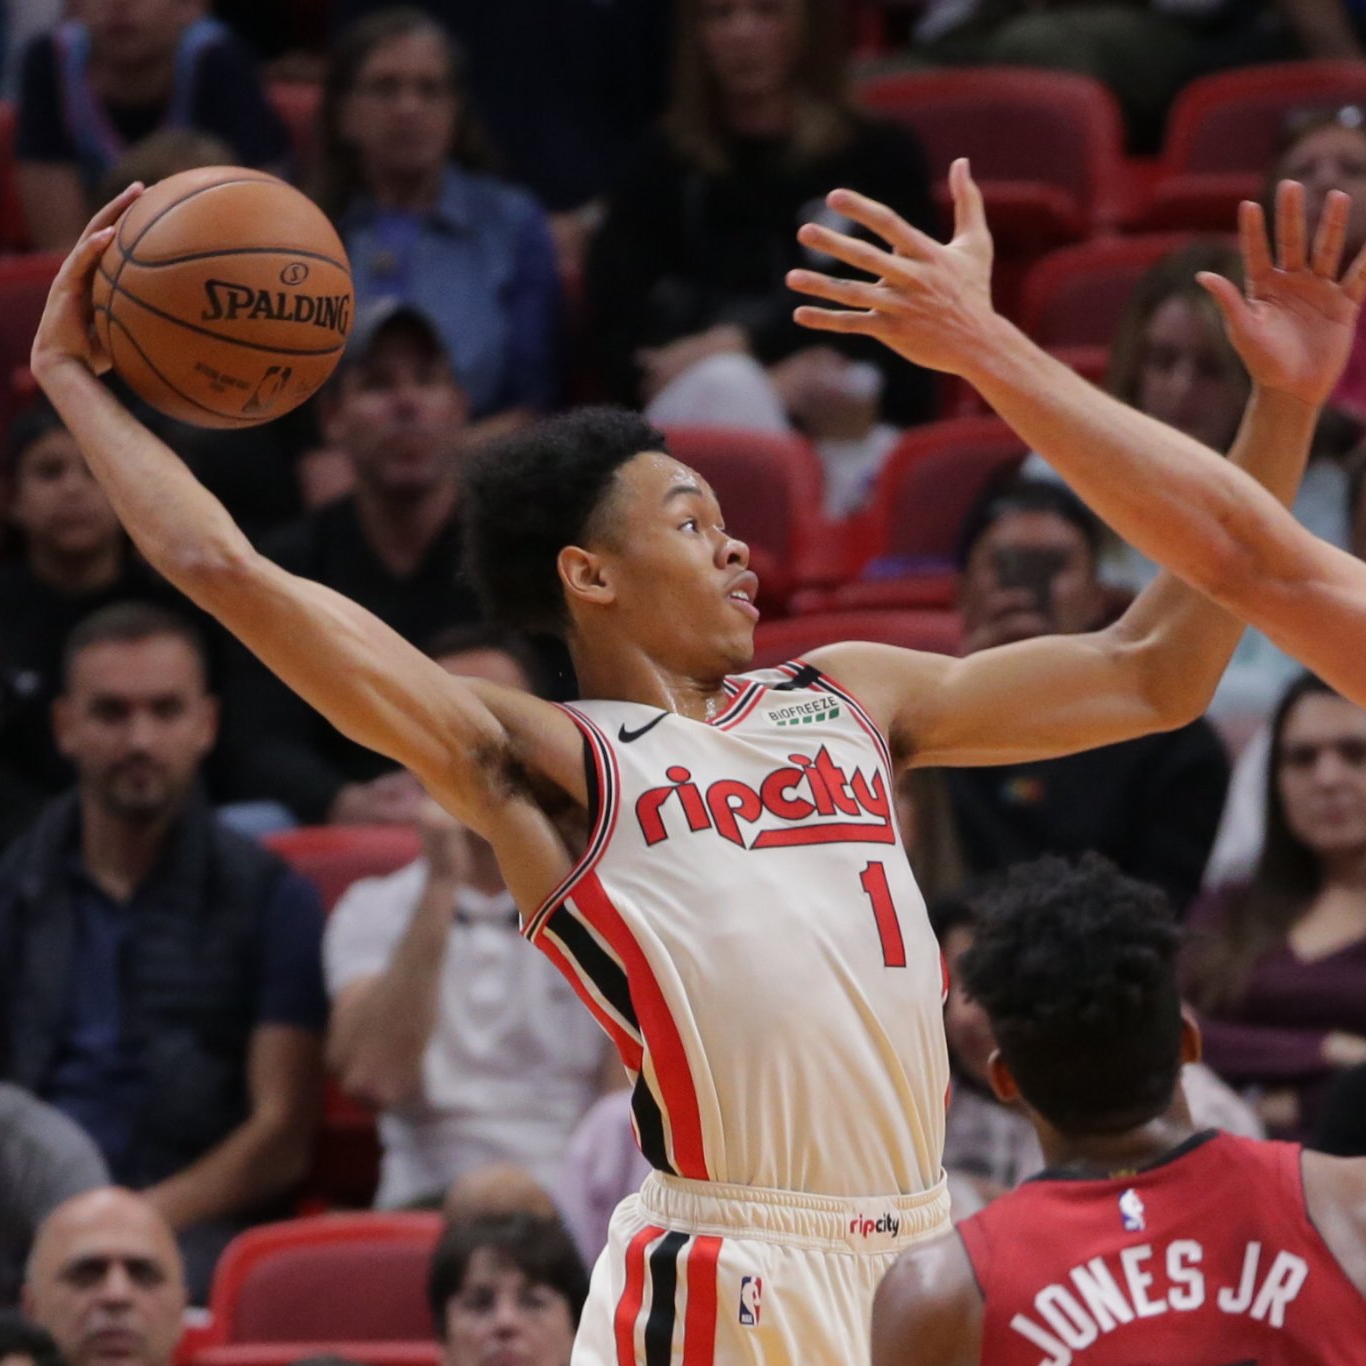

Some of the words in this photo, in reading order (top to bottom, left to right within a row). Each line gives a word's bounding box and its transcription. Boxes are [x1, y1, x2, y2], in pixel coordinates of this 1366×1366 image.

[201, 278, 350, 336] SPALDING
[768, 696, 838, 722] BIOFREEZE
[635, 743, 896, 850] ripcity
[859, 861, 907, 968] 1
[849, 1212, 900, 1239] ripcity
[1217, 1240, 1309, 1329] JR
